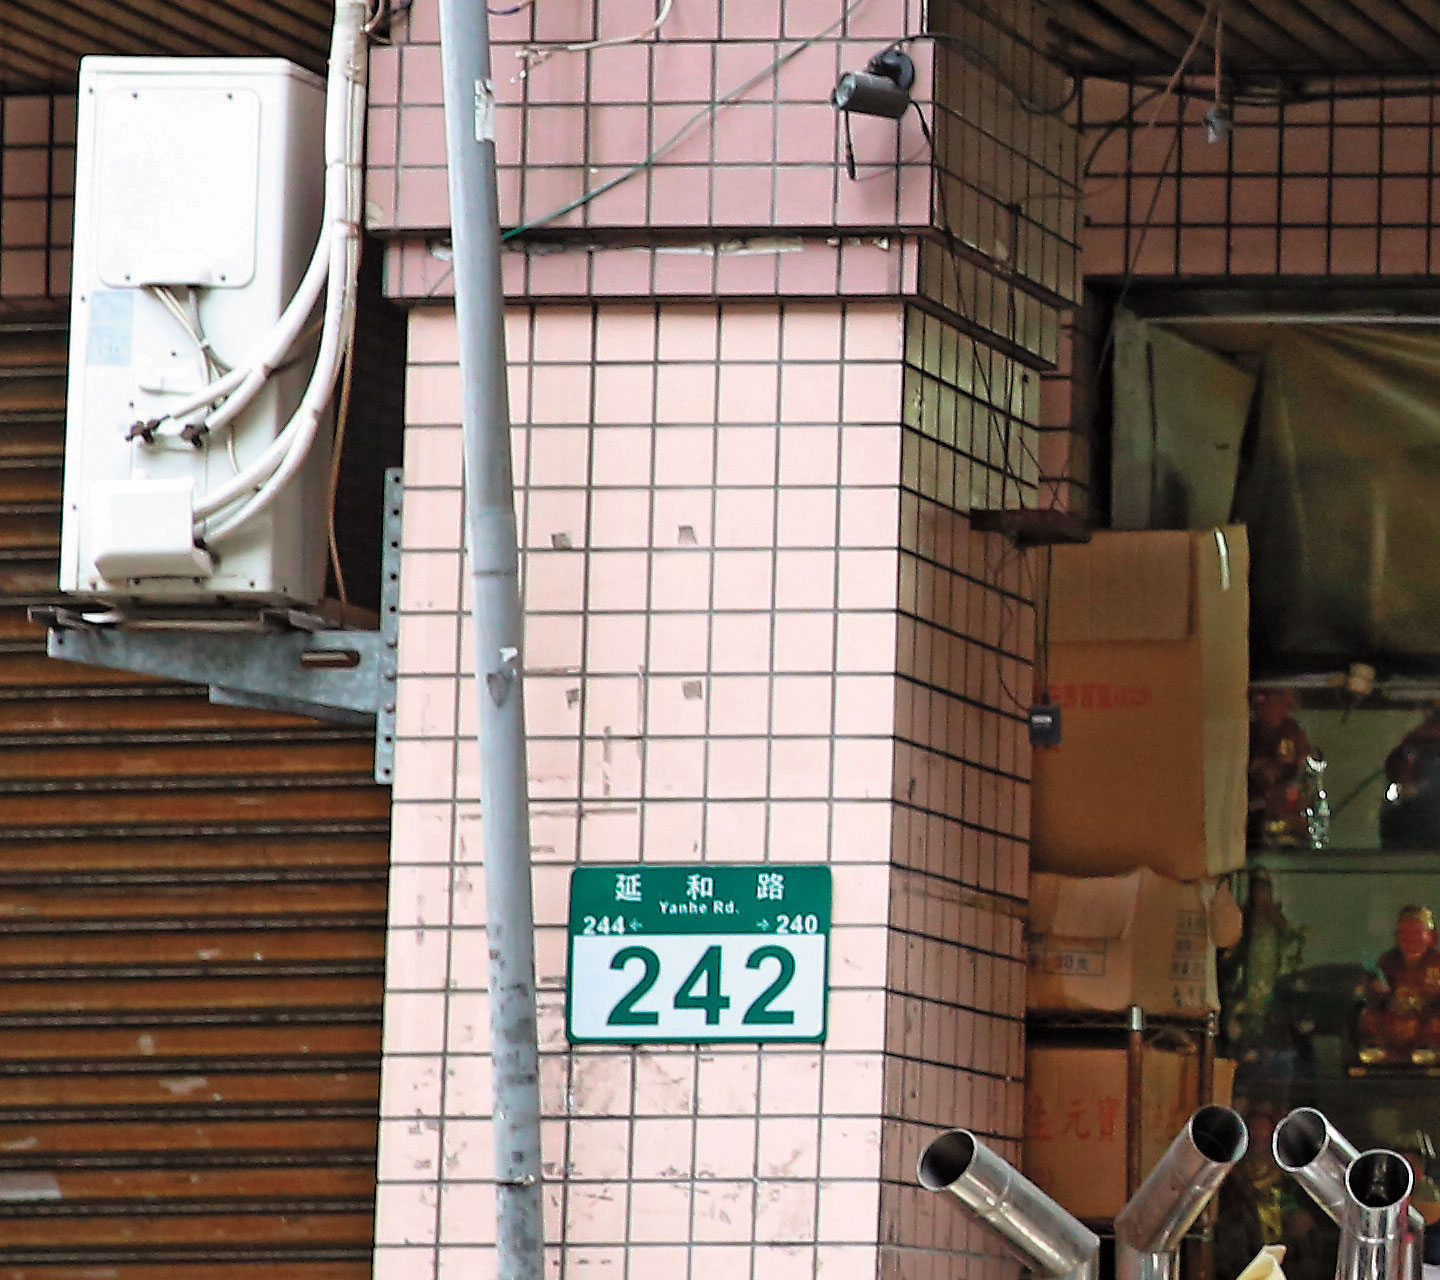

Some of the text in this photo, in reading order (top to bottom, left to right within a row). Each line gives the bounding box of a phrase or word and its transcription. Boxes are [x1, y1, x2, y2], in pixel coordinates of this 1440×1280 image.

[614, 873, 785, 902] 延和路
[658, 900, 741, 915] Yanhe Rd.
[582, 915, 625, 935] 244
[776, 914, 819, 934] 240
[605, 944, 796, 1026] 242
